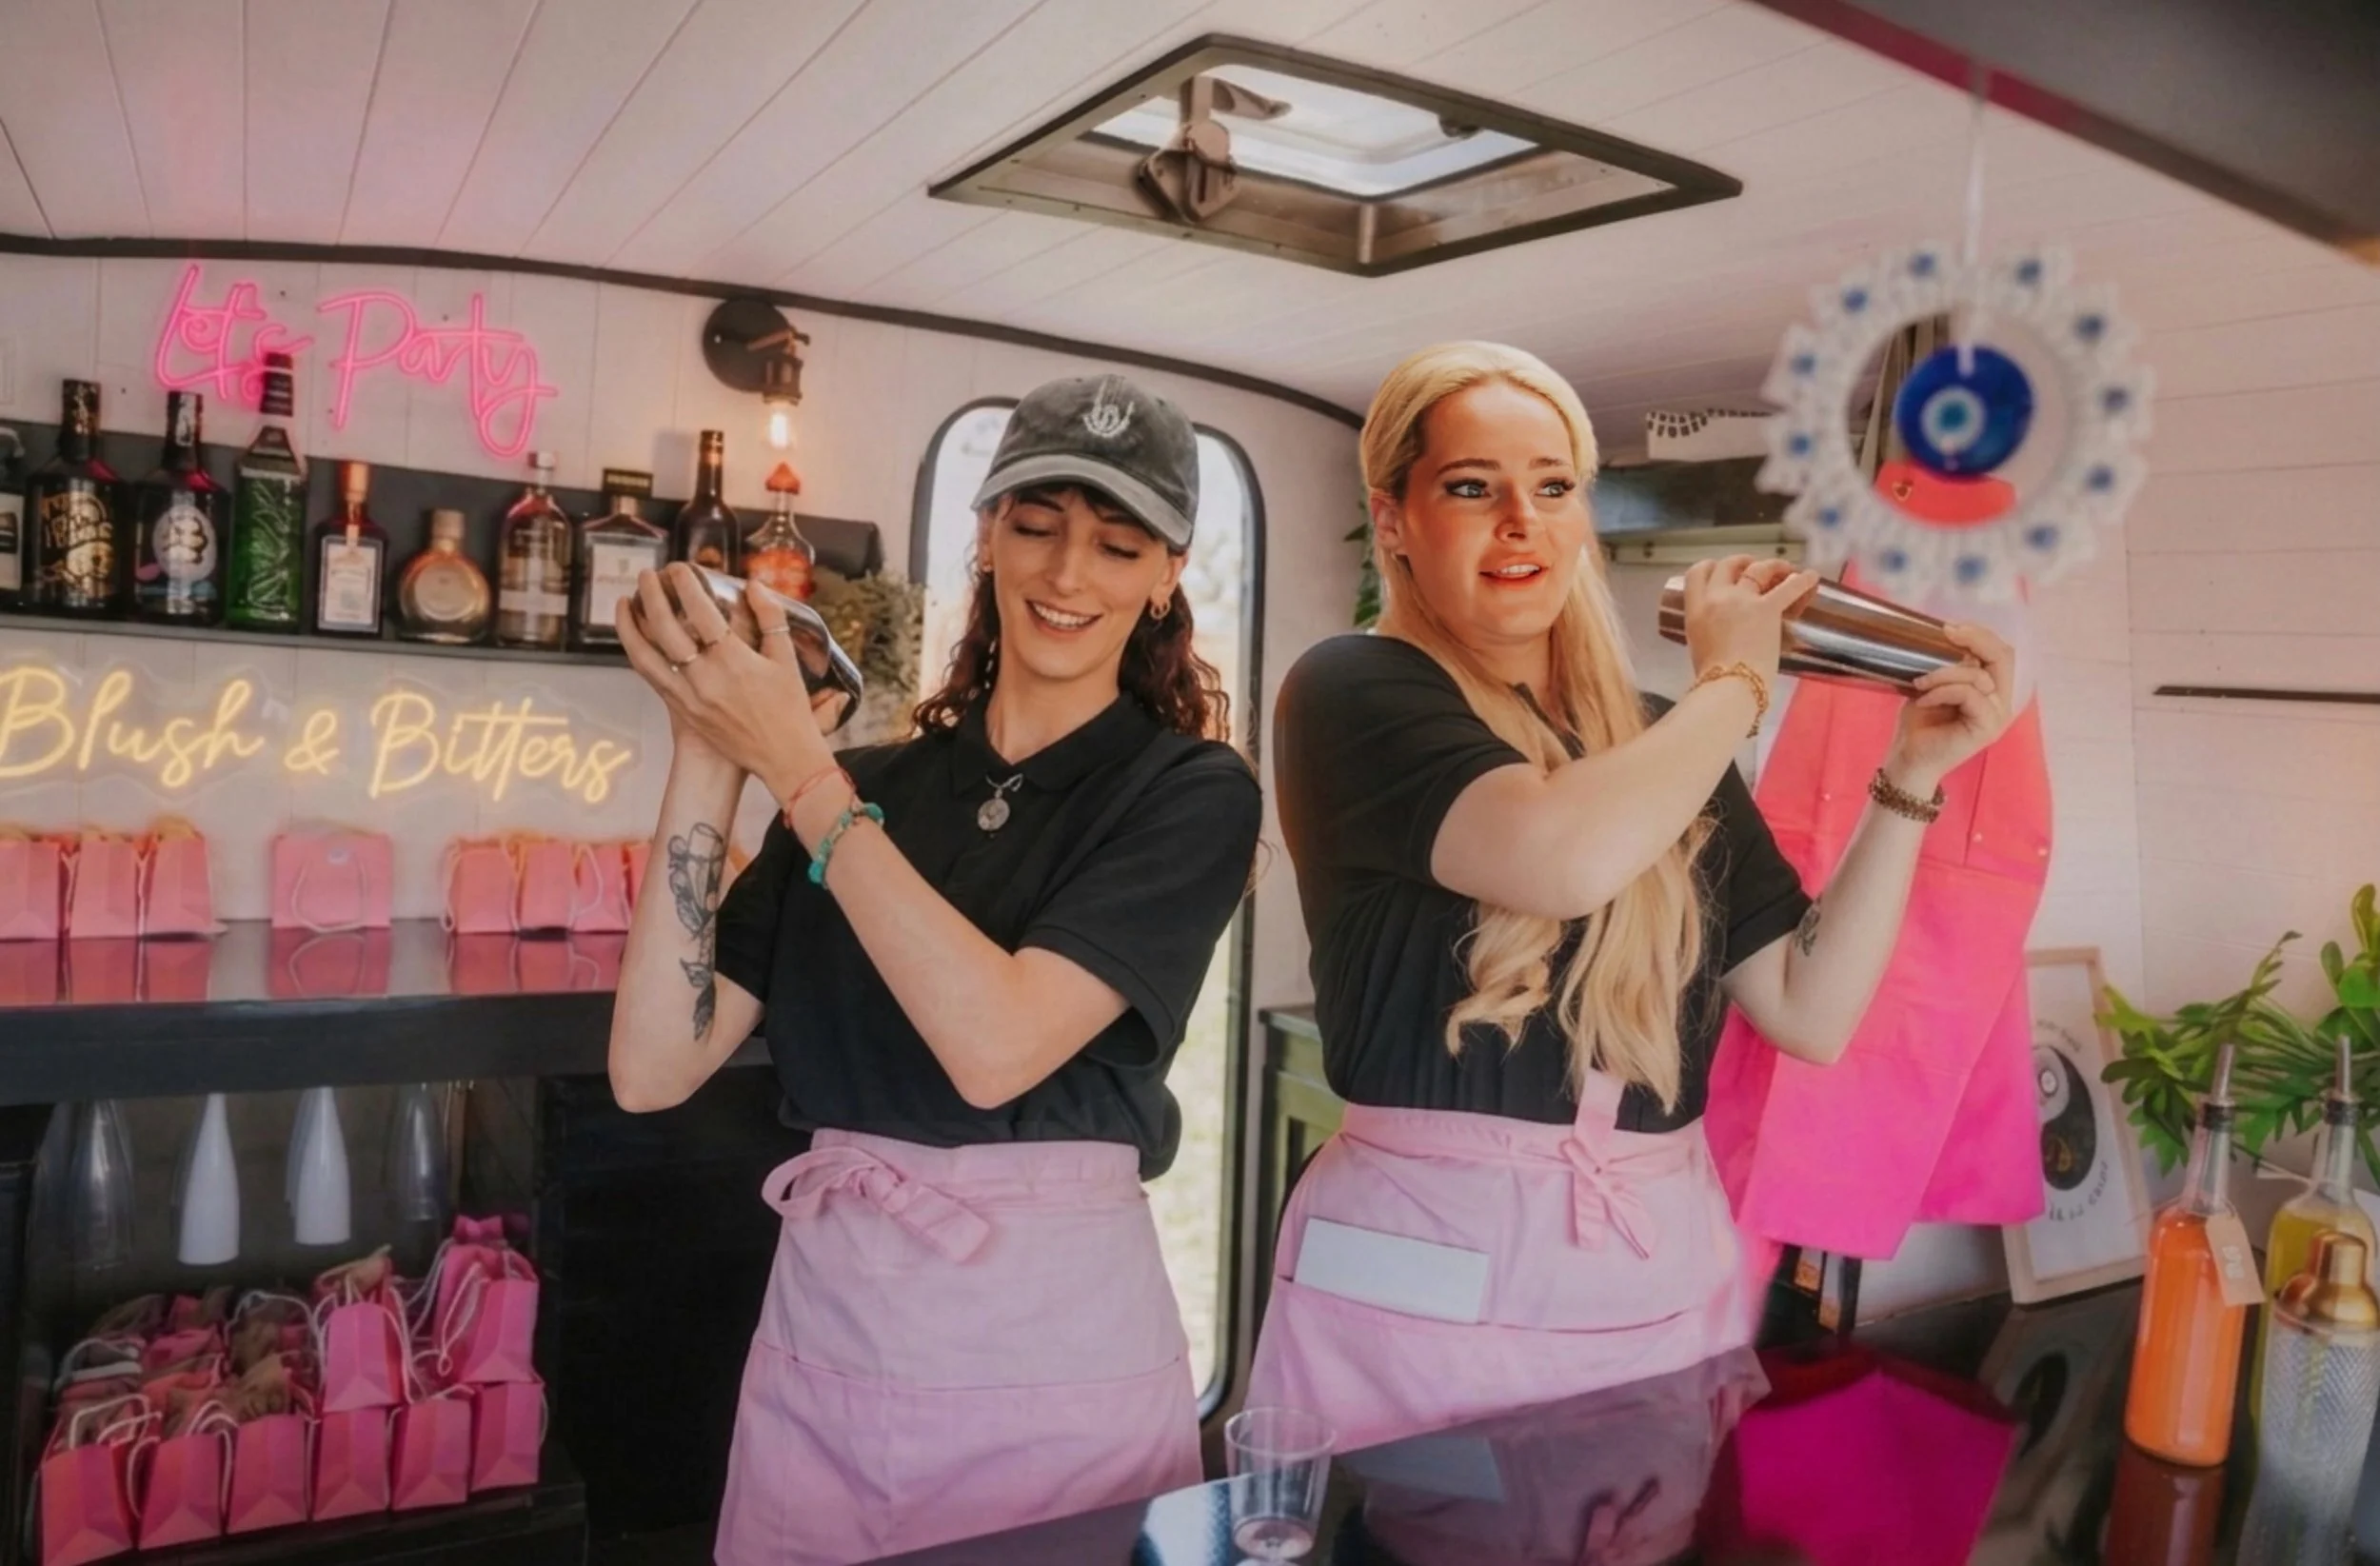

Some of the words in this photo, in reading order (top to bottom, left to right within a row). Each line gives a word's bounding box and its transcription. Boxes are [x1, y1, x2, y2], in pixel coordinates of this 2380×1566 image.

[156, 264, 313, 402] Let's
[316, 291, 558, 457] Party
[0, 664, 265, 788] Blush
[285, 709, 339, 774] &
[368, 689, 631, 803] Bitters
